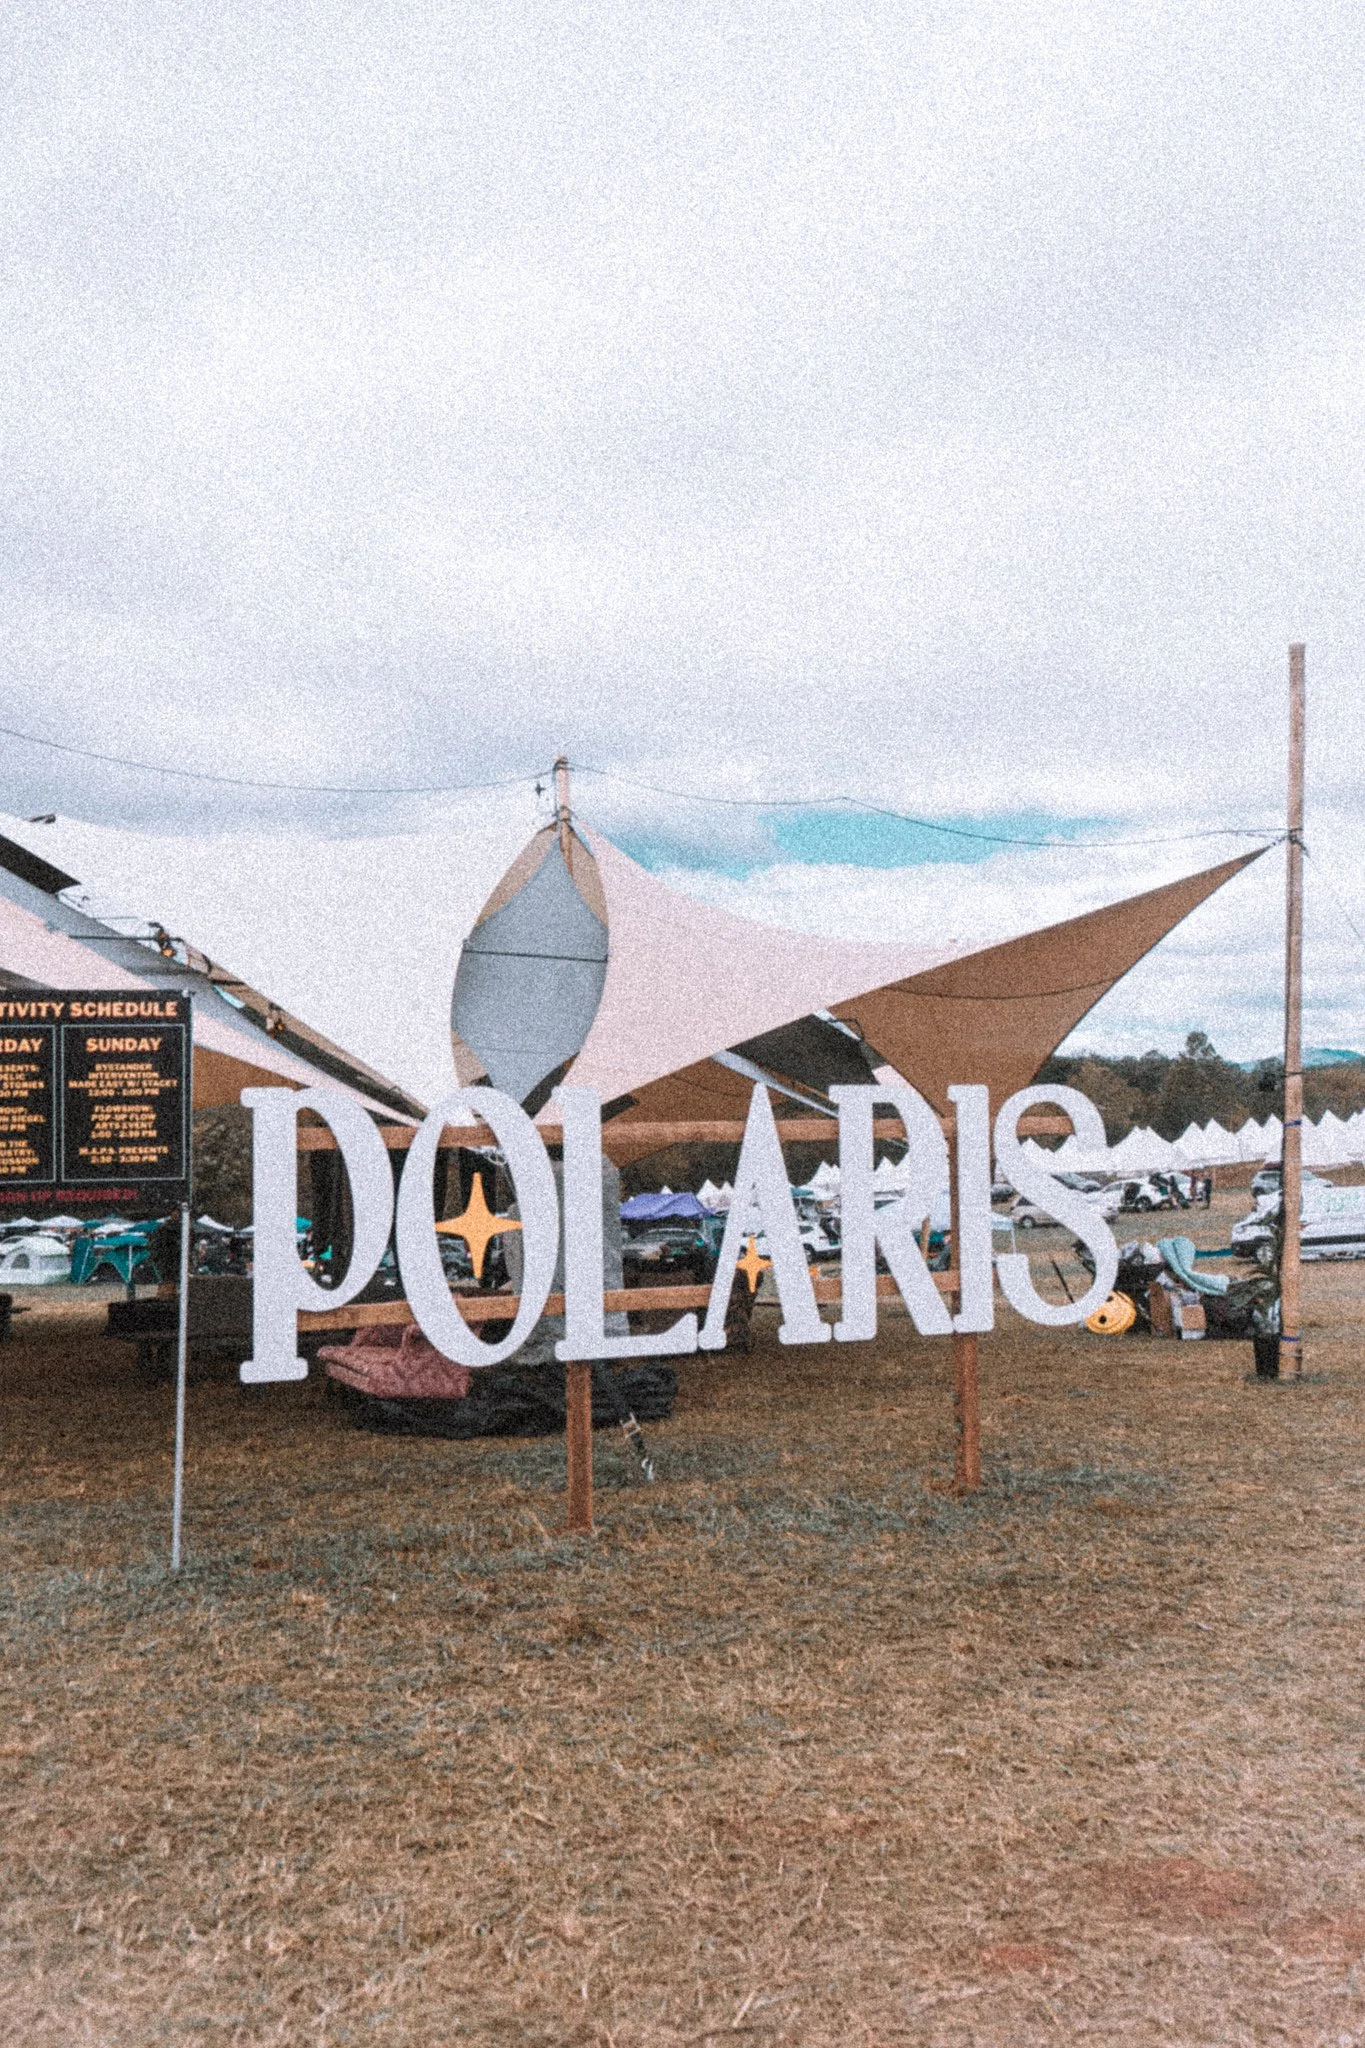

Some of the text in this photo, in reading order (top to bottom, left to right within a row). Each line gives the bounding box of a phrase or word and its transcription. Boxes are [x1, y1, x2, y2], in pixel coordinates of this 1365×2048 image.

[69, 1001, 178, 1018] SCHEDULE
[85, 1037, 162, 1052] SUNDAY
[88, 1072, 159, 1080] INTERVENTION
[2, 1081, 45, 1089] STORIES
[68, 1080, 97, 1088] MADE
[99, 1080, 124, 1088] EASY
[12, 1089, 29, 1097] PM
[10, 1123, 26, 1131] PM
[239, 1083, 1119, 1384] POLARIS
